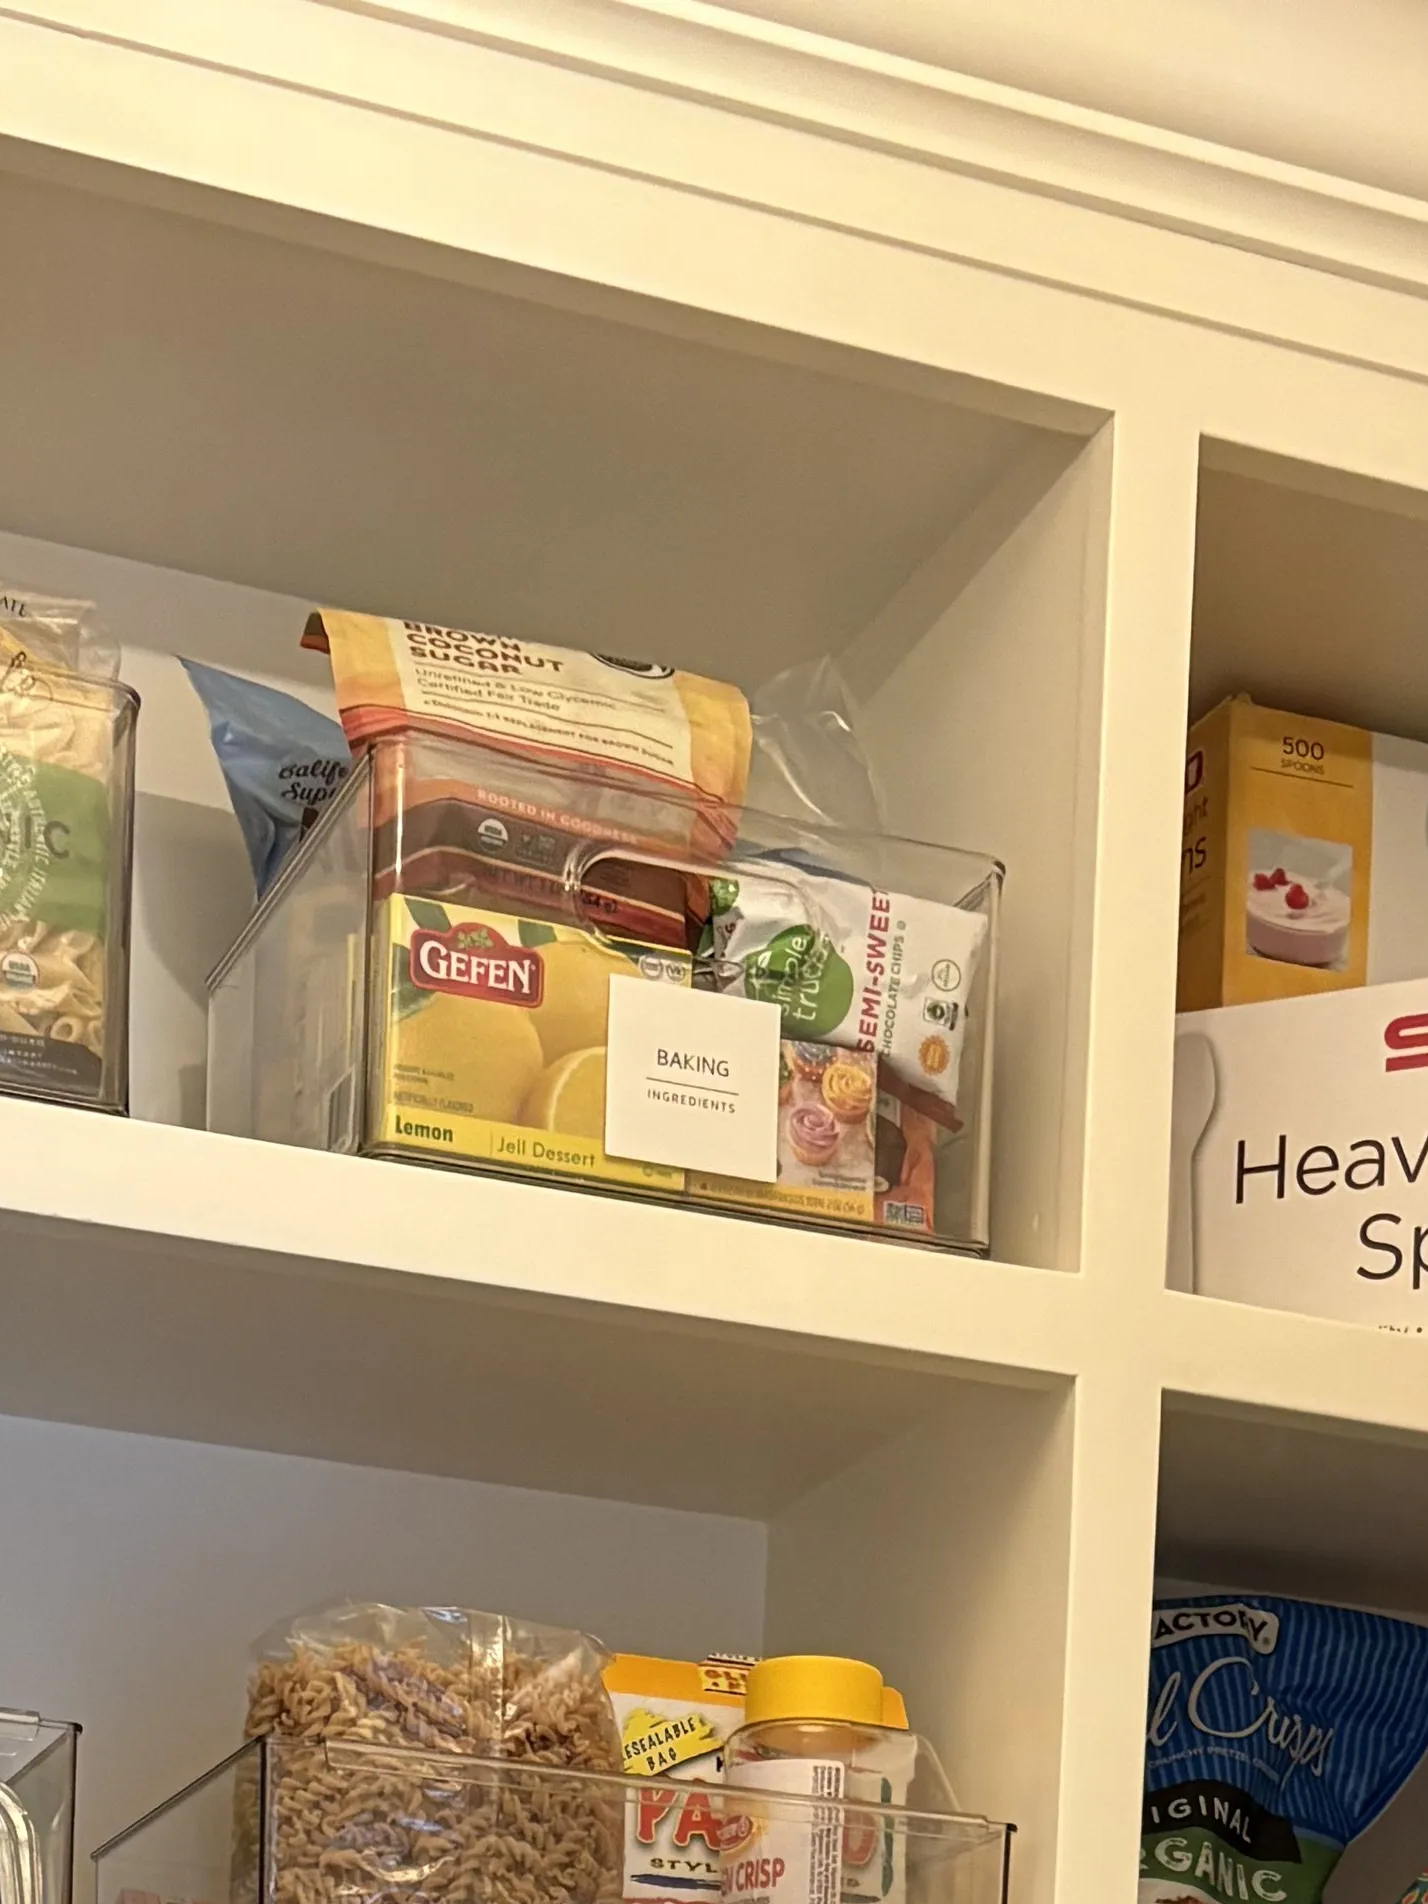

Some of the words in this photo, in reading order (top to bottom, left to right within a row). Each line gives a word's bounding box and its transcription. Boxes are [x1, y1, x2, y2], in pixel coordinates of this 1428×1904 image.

[406, 633, 565, 673] COCONUT
[410, 646, 524, 676] SUGAR
[1282, 736, 1326, 761] 500
[476, 788, 537, 818] ROOTED
[540, 805, 558, 823] IN
[419, 940, 532, 995] GEFEN
[656, 1048, 731, 1078] BAKING
[646, 1088, 738, 1115] INGREDIENTS
[395, 1114, 454, 1143] Lemon
[496, 1135, 527, 1156] Jell
[531, 1141, 596, 1169] Dessert
[1188, 1655, 1335, 1793] Crisps
[647, 1747, 679, 1772] BAG
[735, 1857, 785, 1892] CRISP
